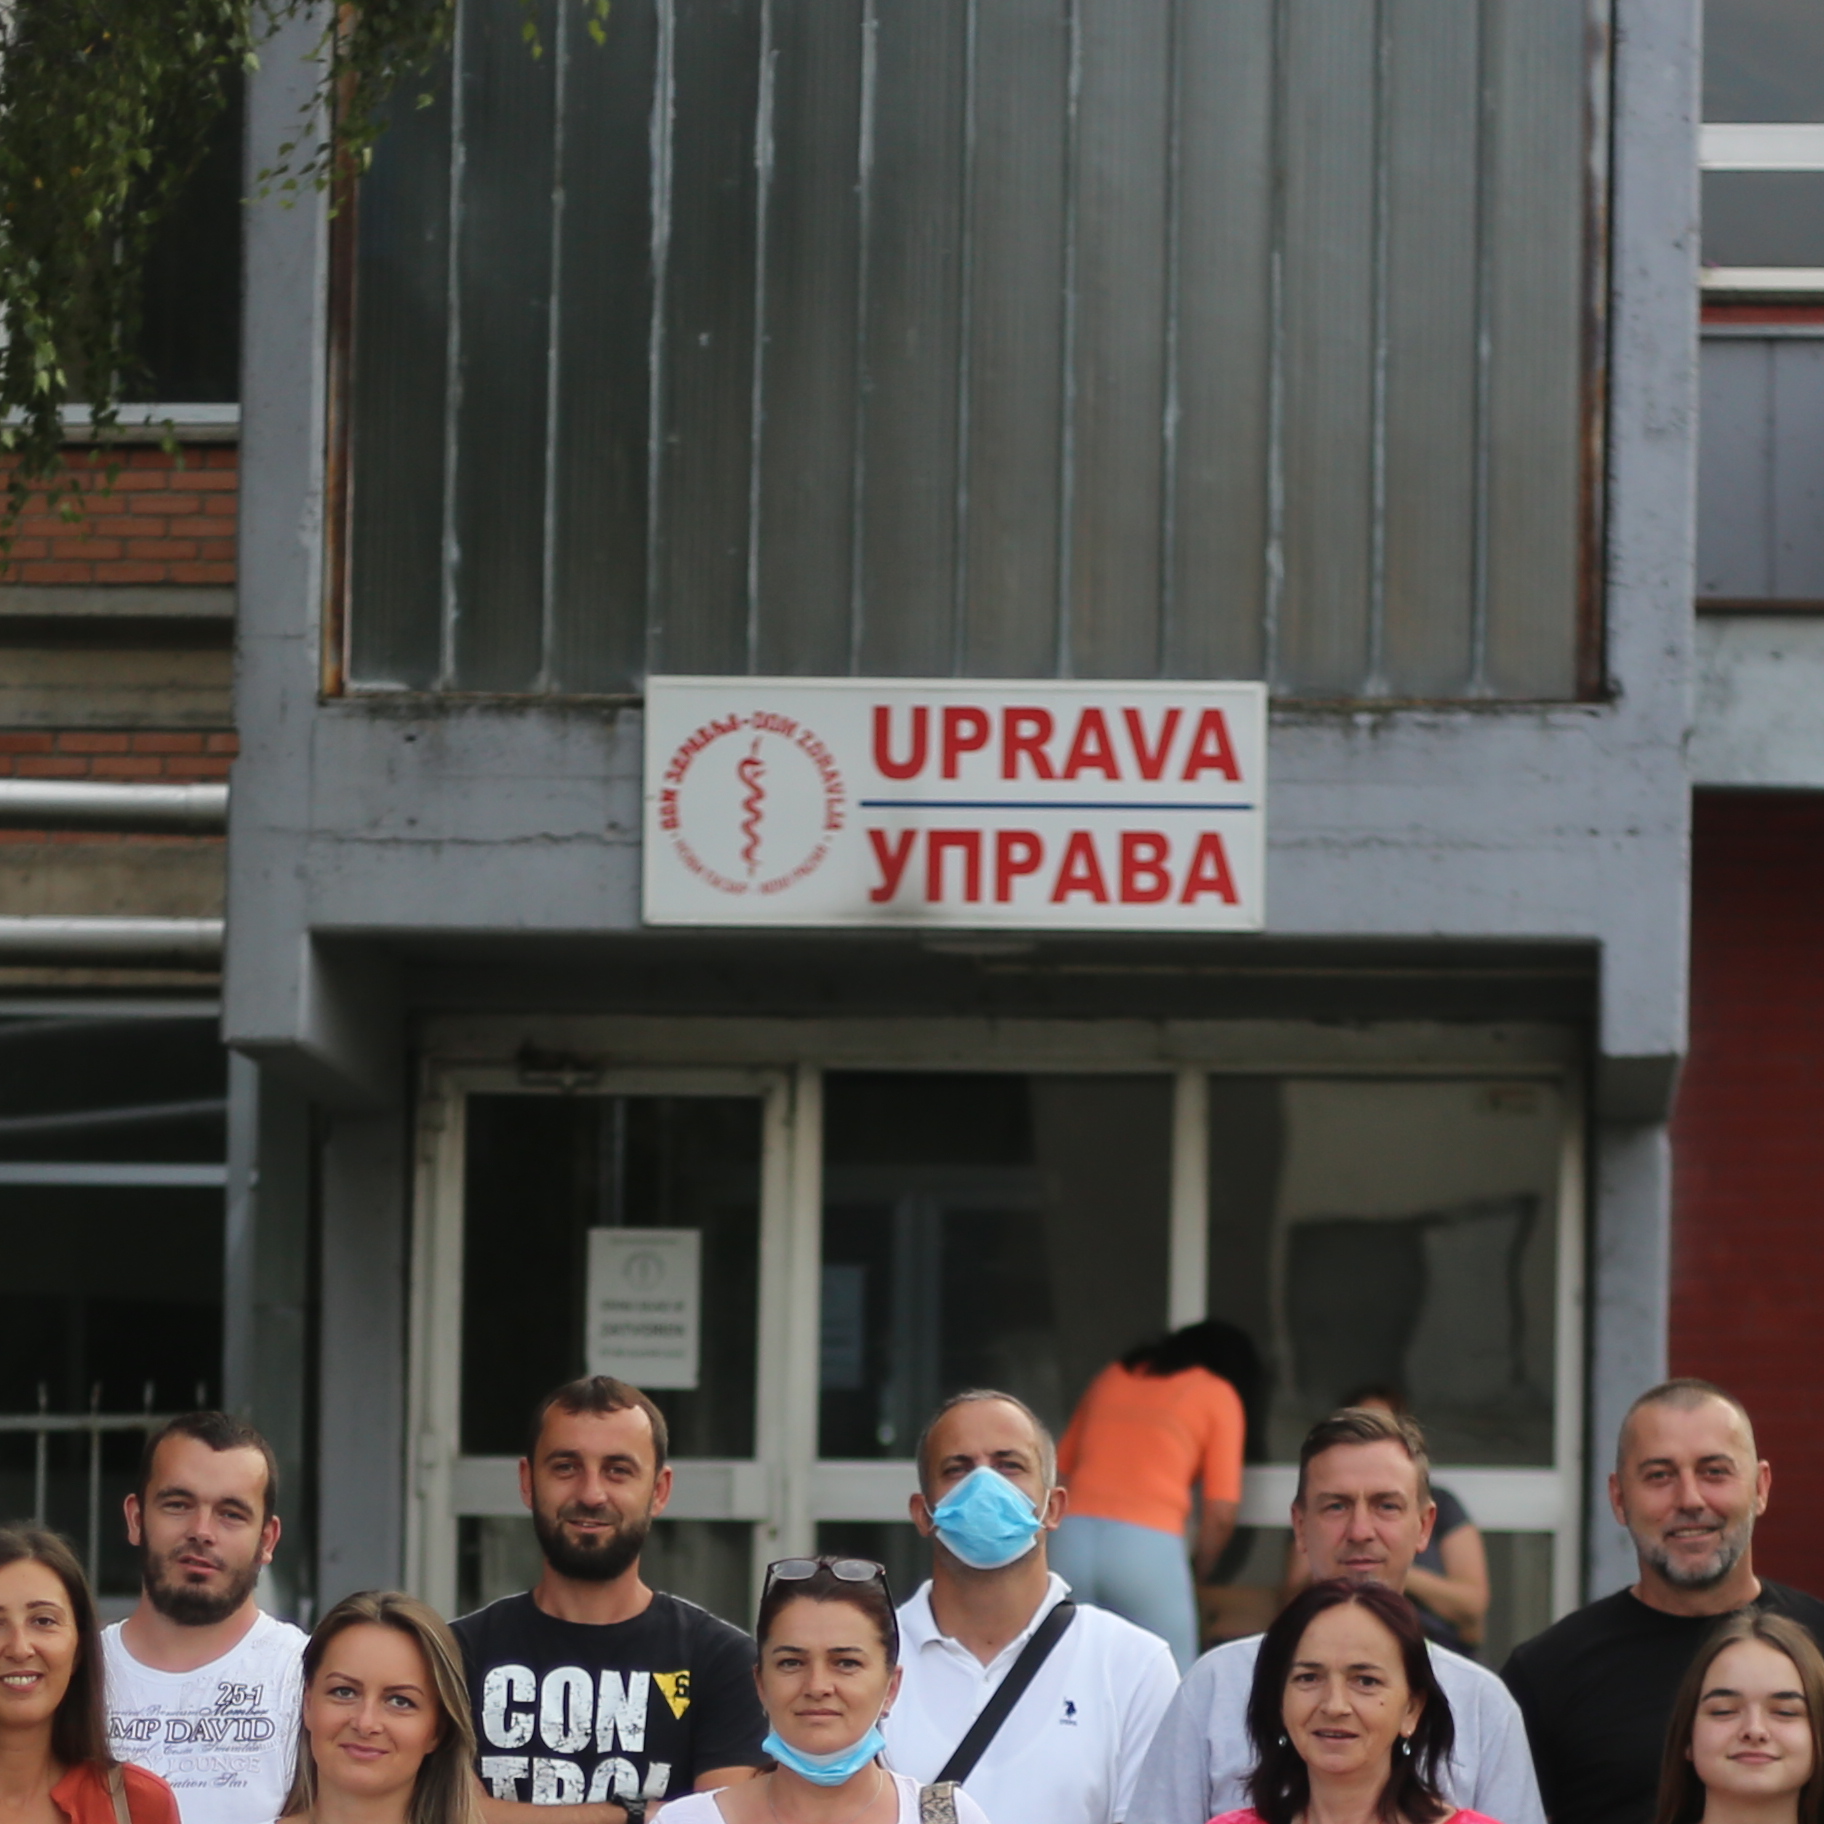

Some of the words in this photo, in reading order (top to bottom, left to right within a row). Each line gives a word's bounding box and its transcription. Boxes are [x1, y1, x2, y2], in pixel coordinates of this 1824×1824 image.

[795, 728, 845, 831] ZDRAVLJA
[872, 705, 1242, 782] UPRAVA
[867, 828, 1239, 904] УПРАВА
[109, 1717, 162, 1742] MP
[164, 1717, 276, 1744] DAVID
[215, 1682, 264, 1706] 25-1
[481, 1664, 651, 1754] CON
[167, 1756, 262, 1774] LOUNGE
